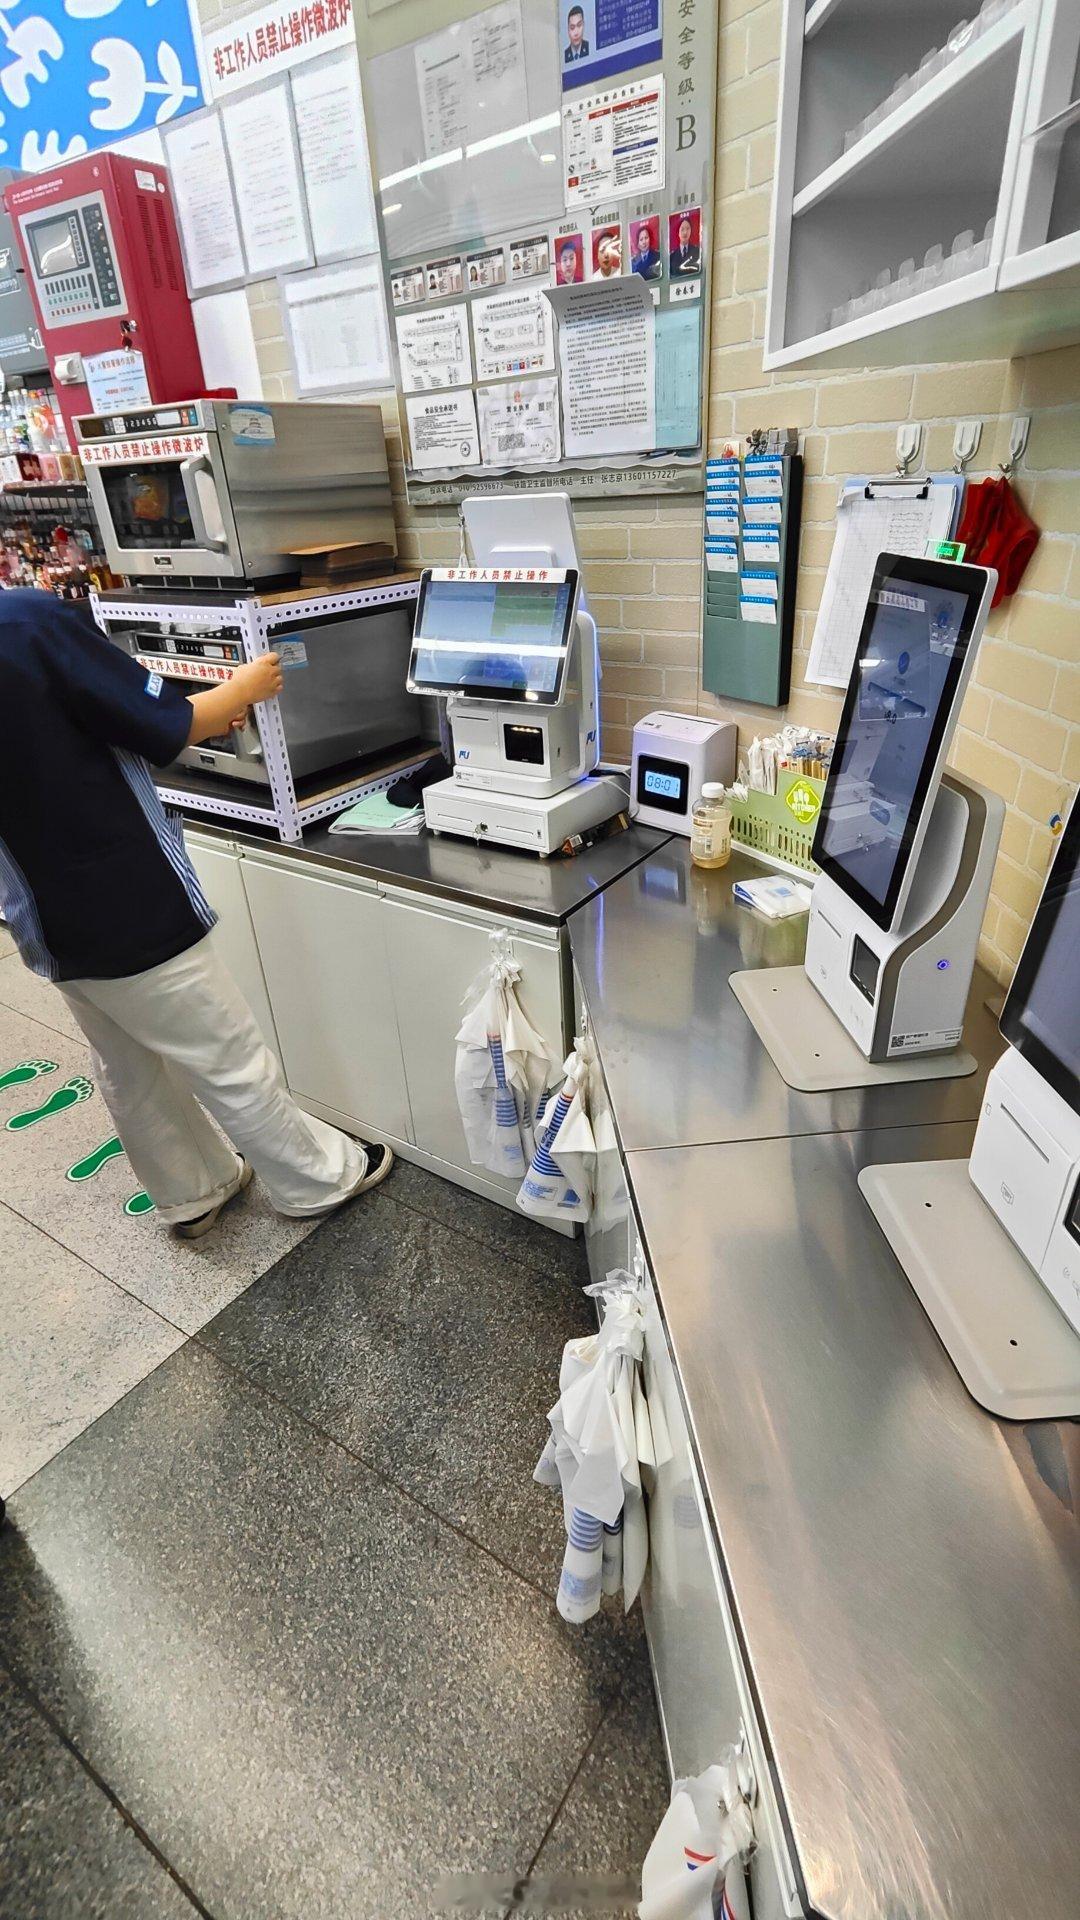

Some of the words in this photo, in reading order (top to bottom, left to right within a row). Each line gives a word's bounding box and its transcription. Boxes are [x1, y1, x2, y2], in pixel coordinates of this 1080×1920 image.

[213, 0, 352, 80] 非工作人员禁止操作微波炉
[675, 114, 696, 152] B
[84, 436, 204, 462] 非工作人员禁止操作微波炉
[447, 569, 549, 581] 非工作人员禁止操作
